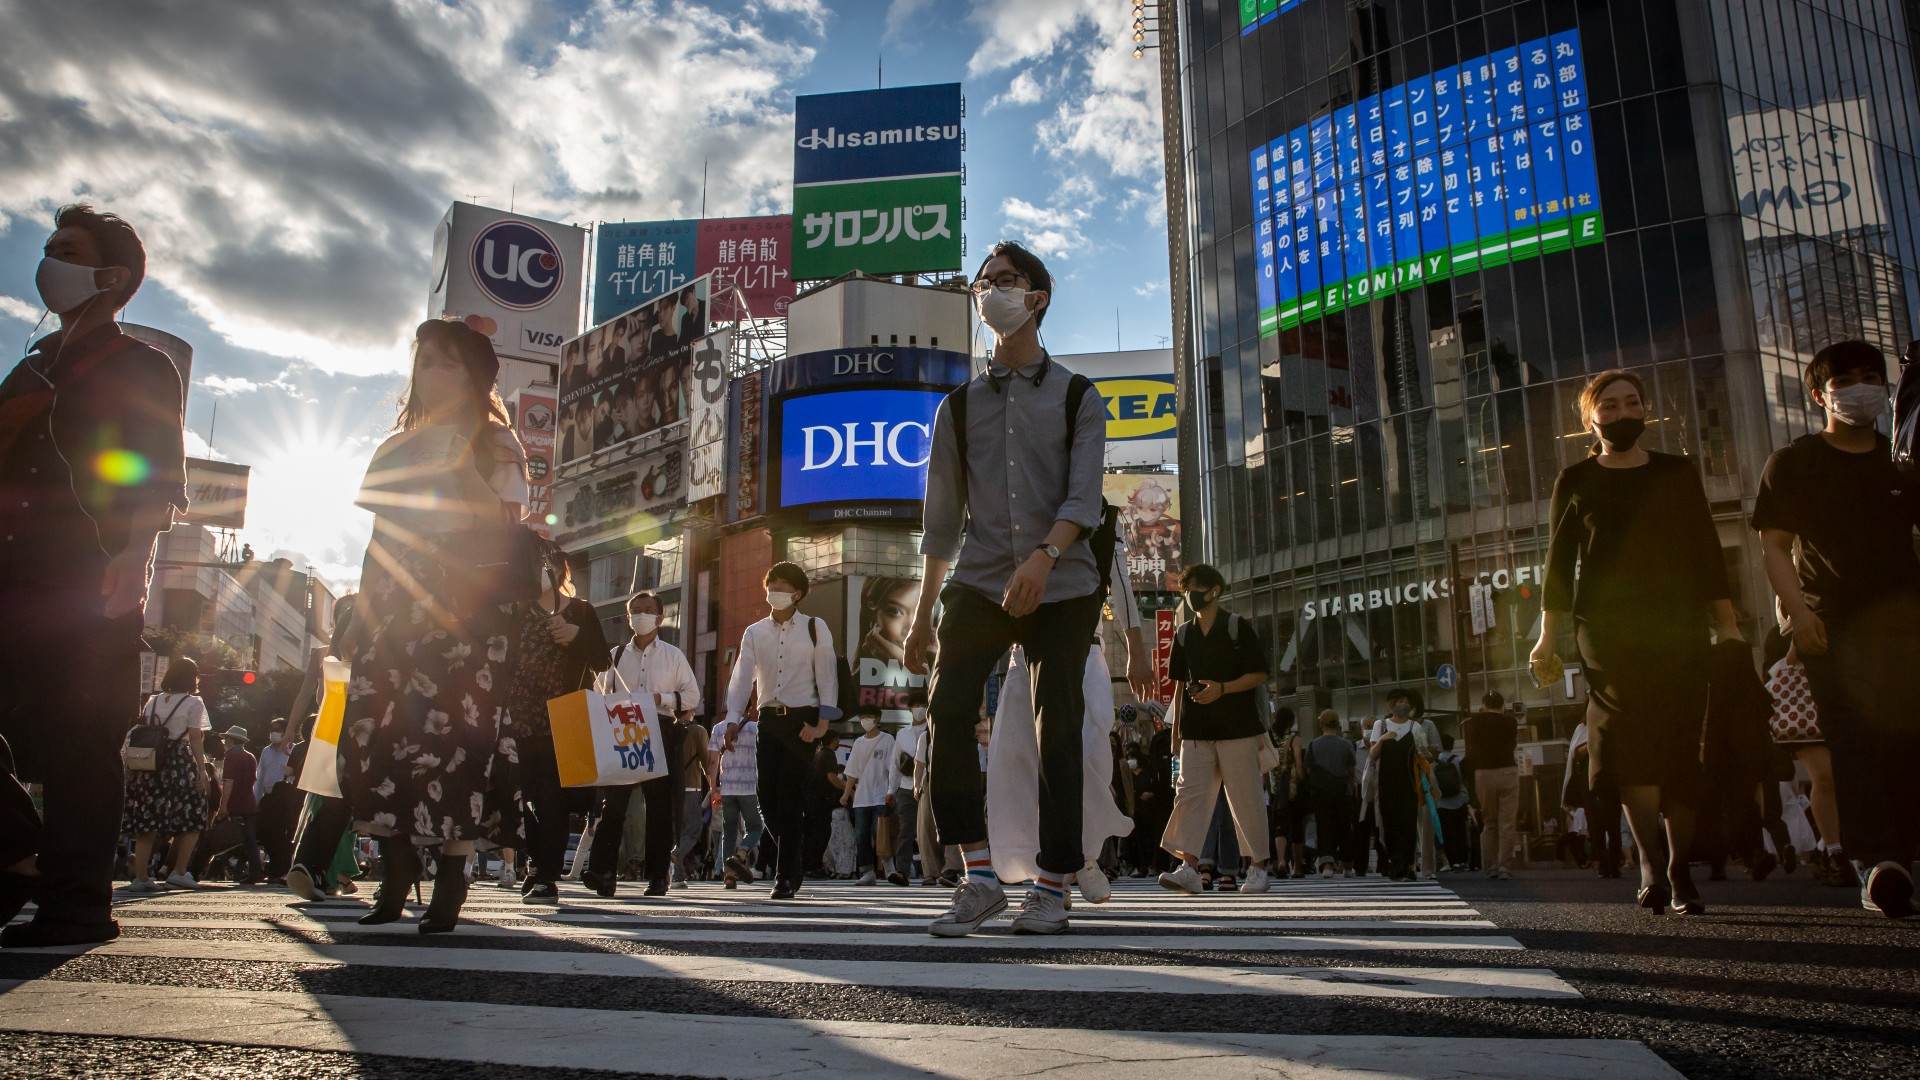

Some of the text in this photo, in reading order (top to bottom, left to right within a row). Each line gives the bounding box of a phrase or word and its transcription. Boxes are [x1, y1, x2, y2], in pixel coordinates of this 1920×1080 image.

[798, 124, 957, 150] Hisamitsu
[803, 204, 951, 248] サロンパス
[617, 242, 676, 268] 龍角散
[718, 237, 779, 263] 龍角散
[608, 268, 686, 295] ダイレクト
[710, 264, 788, 290] ダイレクト
[1326, 255, 1442, 307] ECONOMY
[525, 329, 564, 348] VISA
[833, 352, 894, 376] DHC
[1101, 393, 1177, 420] KEA
[800, 420, 931, 471] DHC
[833, 507, 893, 518] DHC Channel
[1303, 577, 1455, 621] STARBUCKS
[859, 687, 910, 708] Bitc
